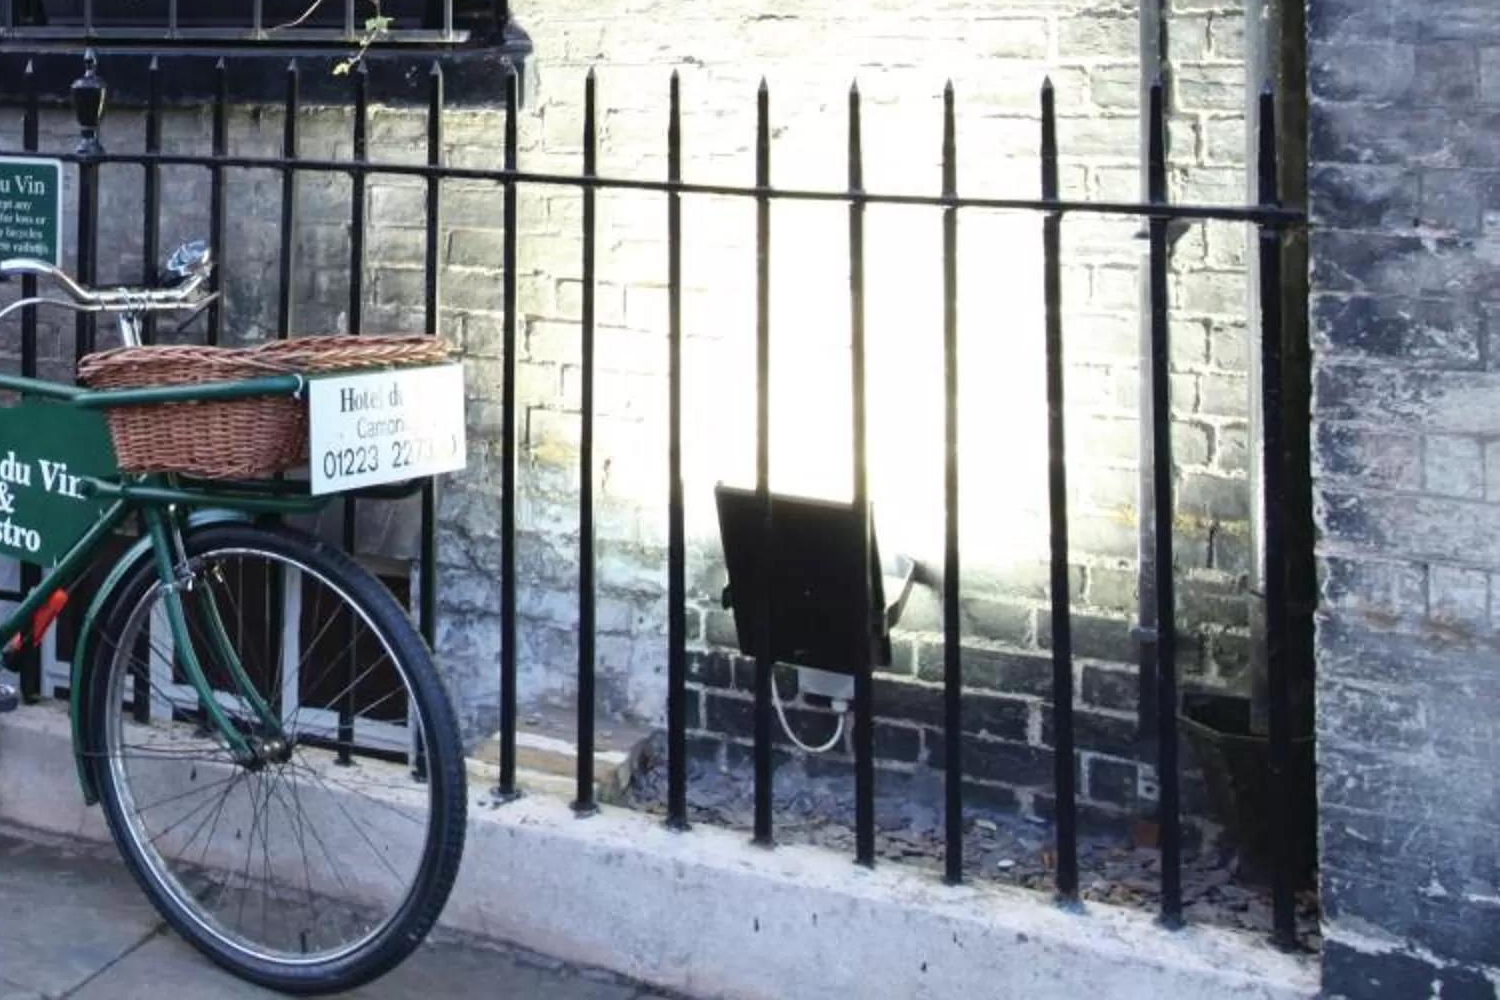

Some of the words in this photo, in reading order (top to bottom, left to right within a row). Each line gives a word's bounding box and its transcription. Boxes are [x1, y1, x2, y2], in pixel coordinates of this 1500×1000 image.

[14, 175, 46, 196] Vin
[0, 451, 31, 486] du
[323, 444, 379, 479] 01223
